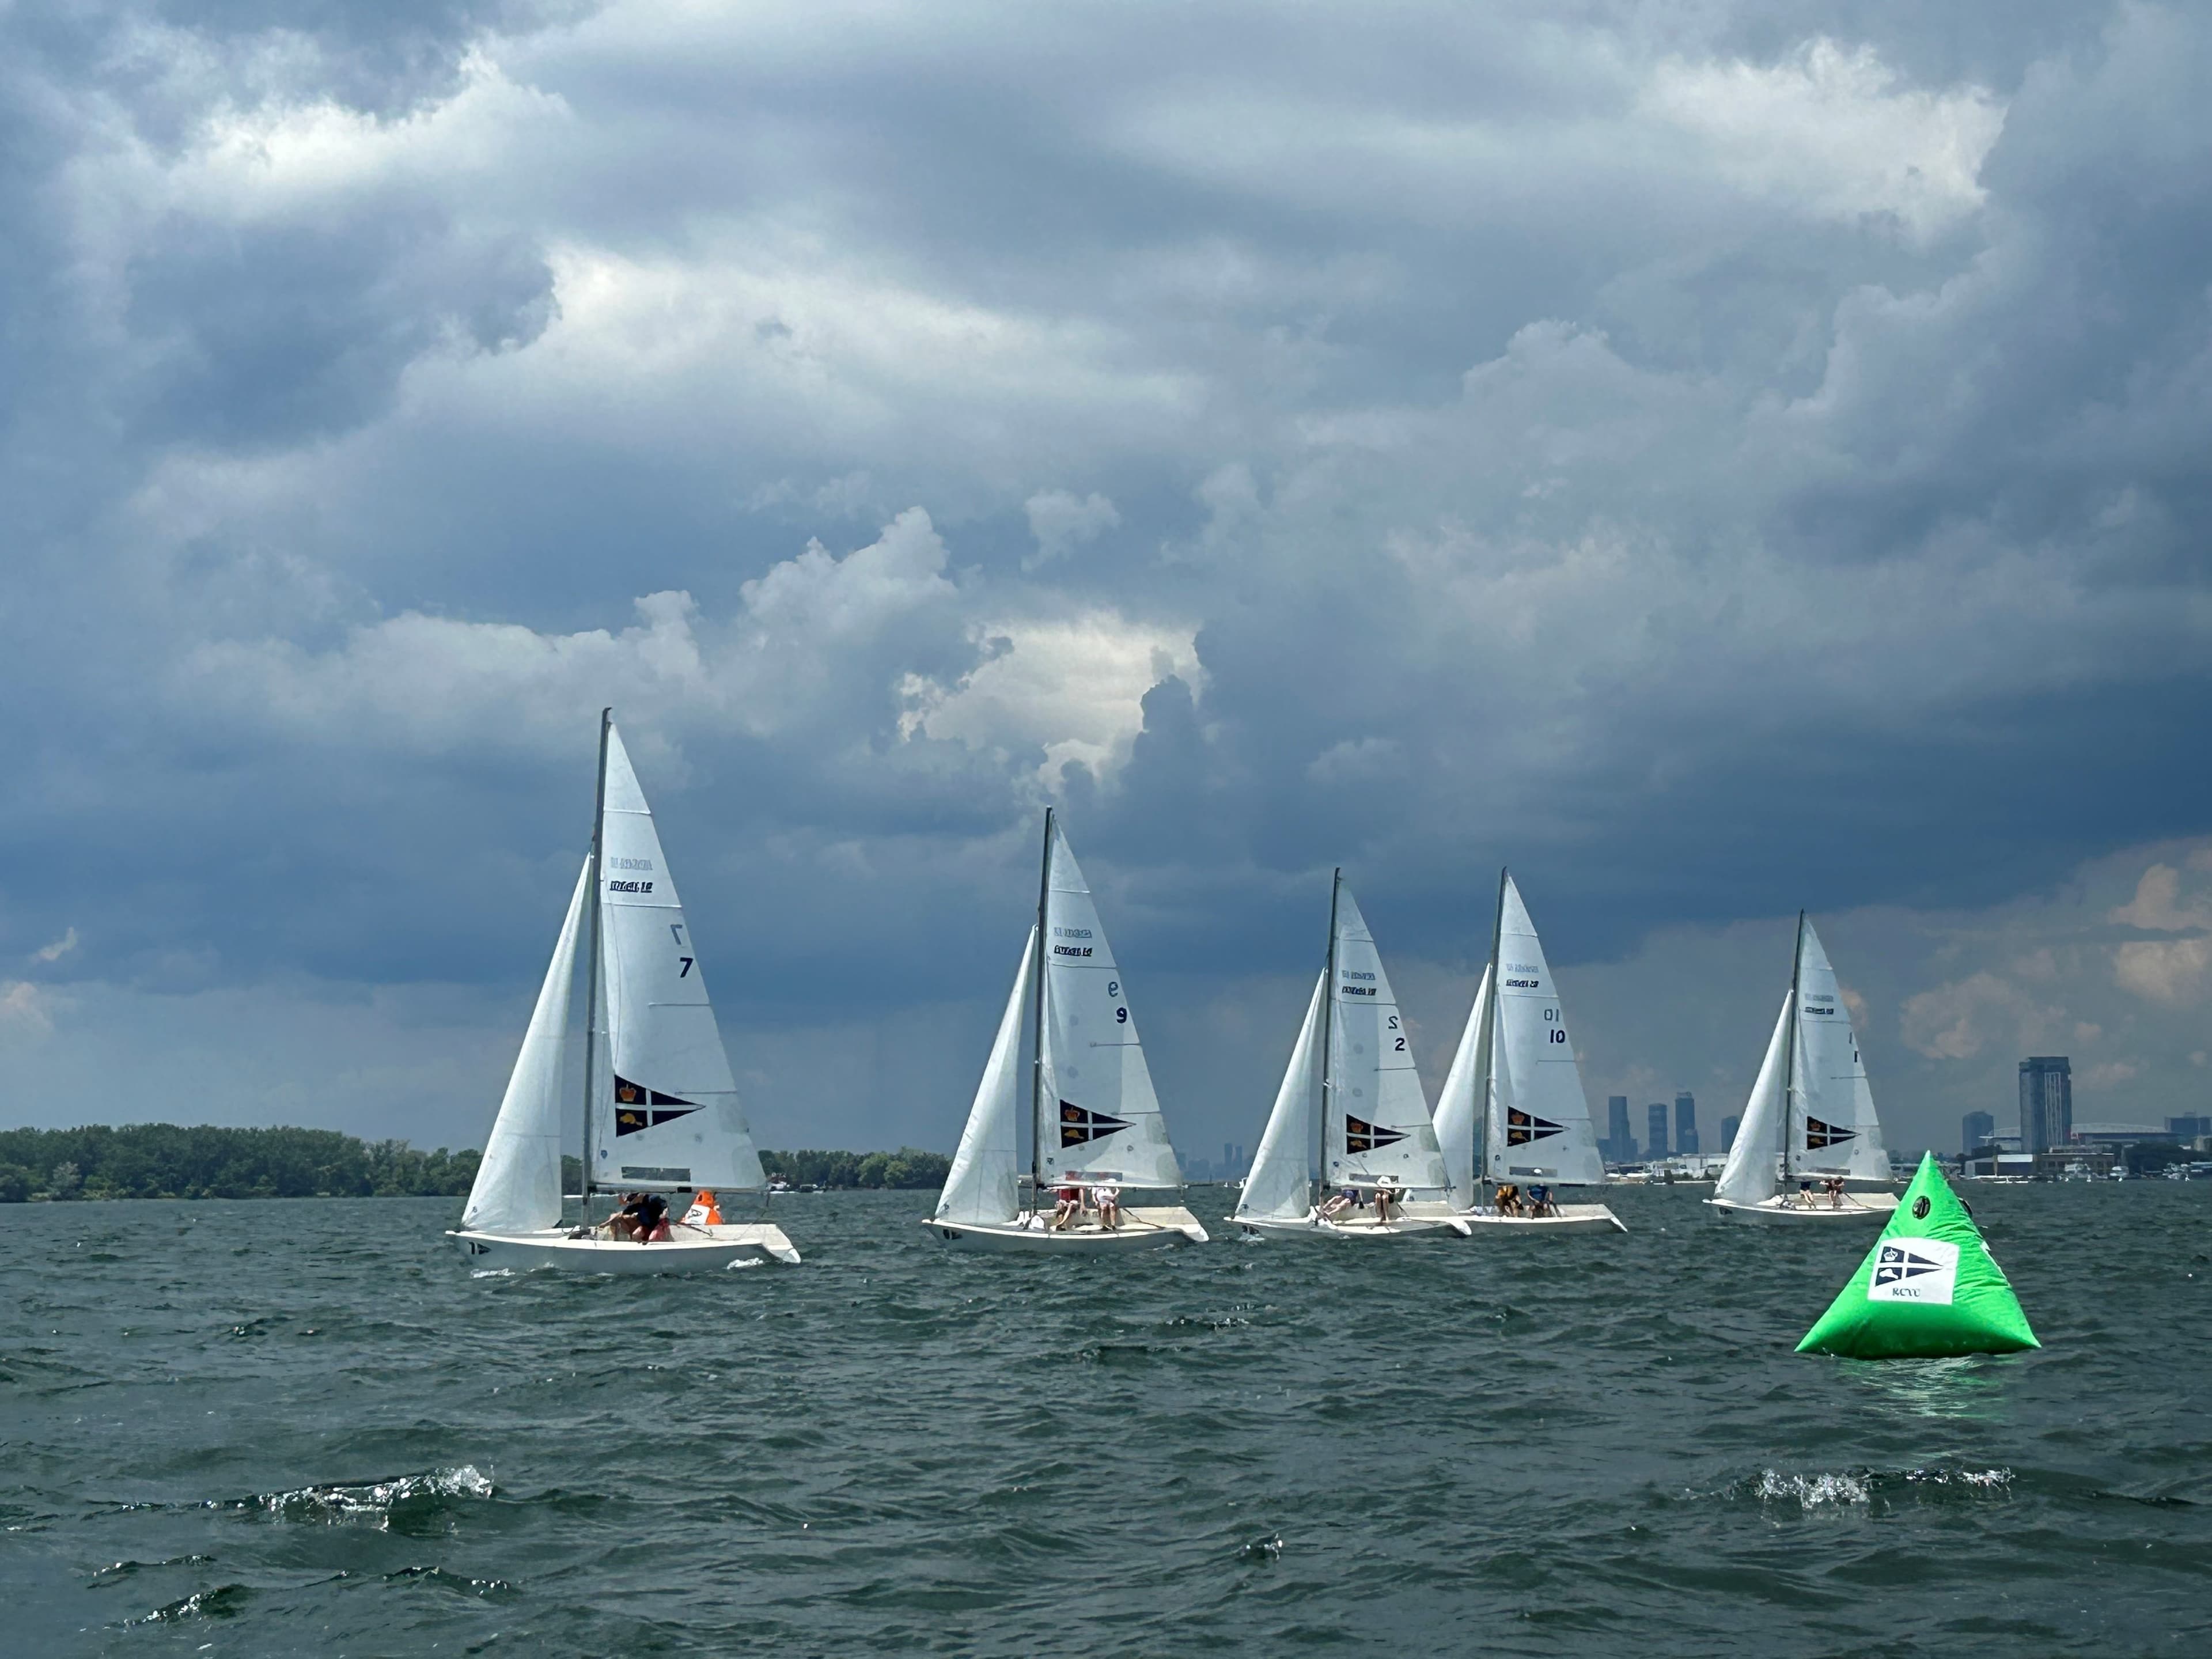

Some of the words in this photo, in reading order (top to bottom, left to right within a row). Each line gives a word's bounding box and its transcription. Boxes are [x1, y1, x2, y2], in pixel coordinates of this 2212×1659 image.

[679, 956, 694, 978] 7
[1116, 1007, 1127, 1024] 9
[1395, 1037, 1406, 1051] 2
[1550, 1029, 1566, 1044] 10
